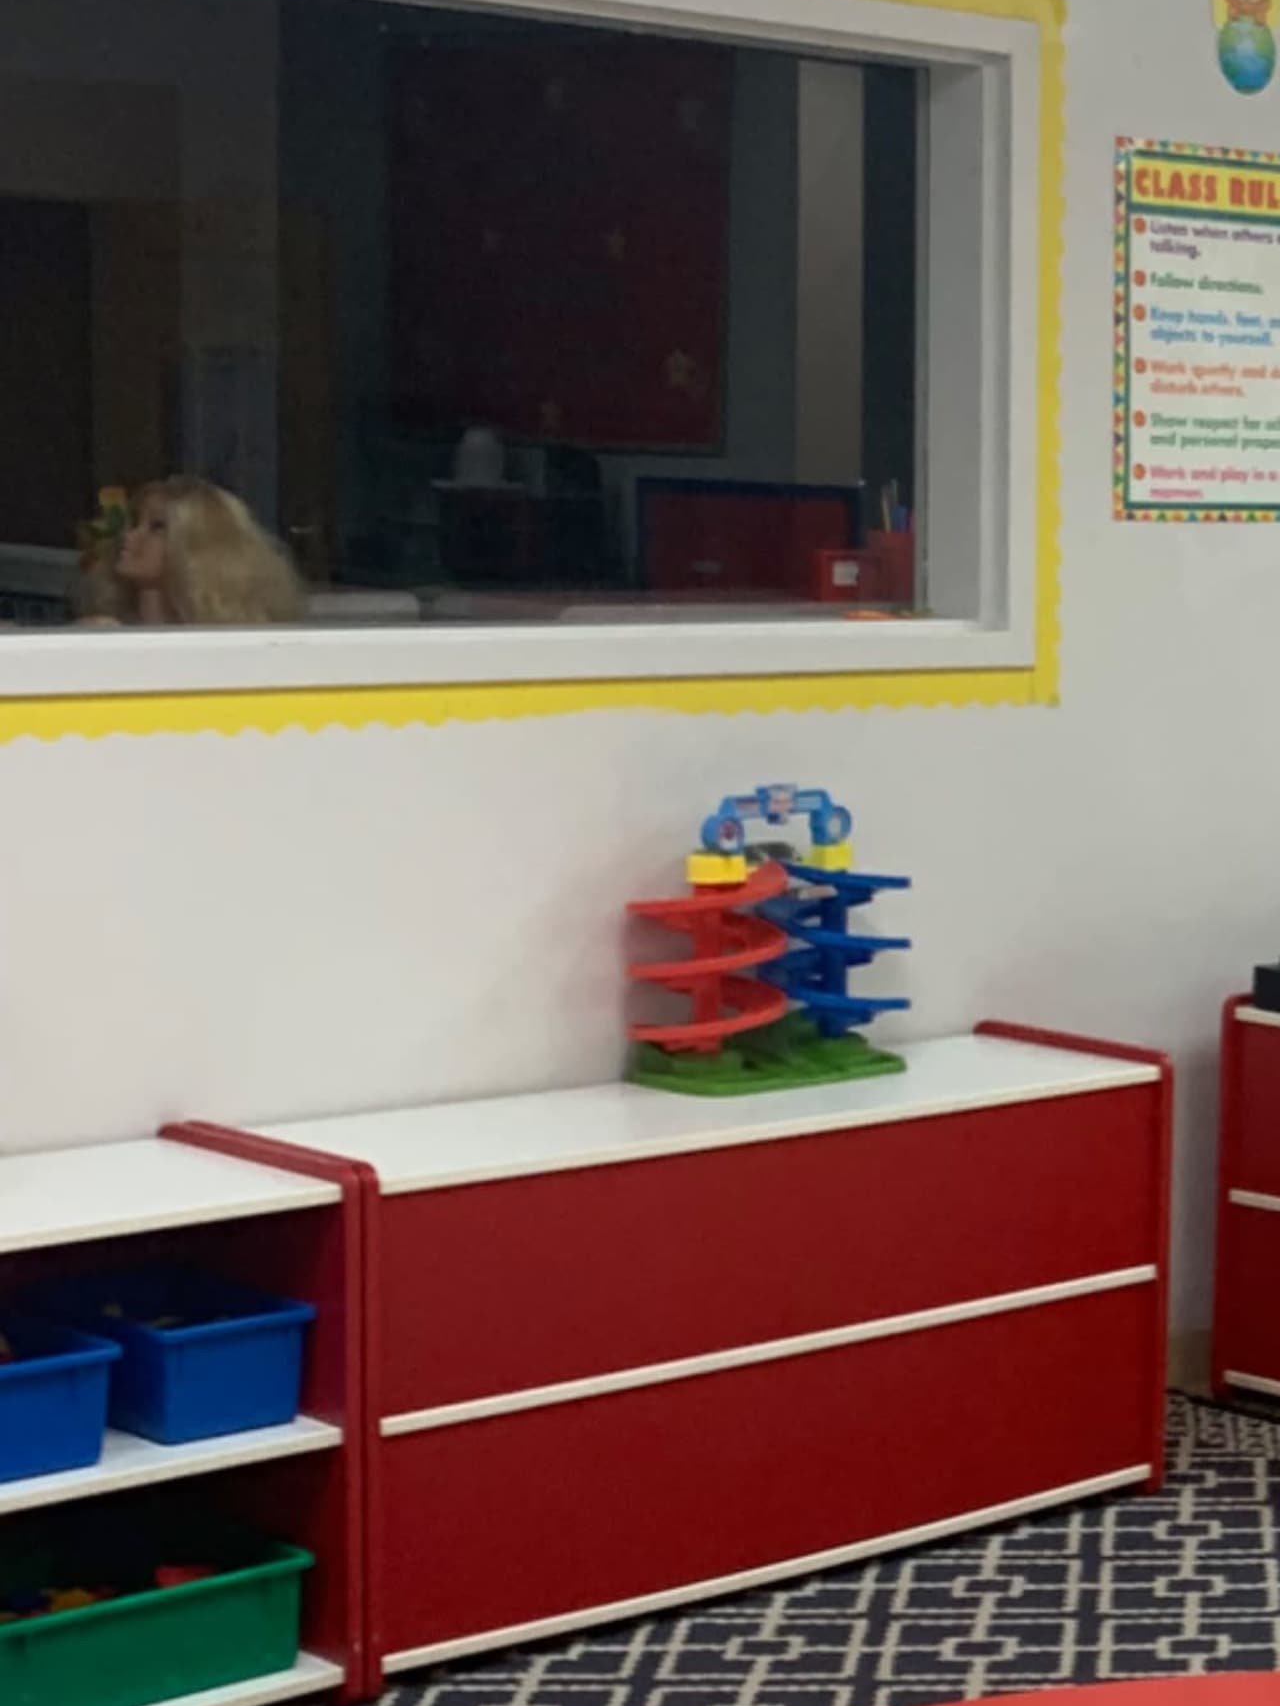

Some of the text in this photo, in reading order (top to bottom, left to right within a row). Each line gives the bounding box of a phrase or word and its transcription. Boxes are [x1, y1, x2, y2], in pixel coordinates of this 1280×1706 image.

[1134, 167, 1218, 203] CLASS
[1150, 219, 1188, 236] Listen
[1192, 225, 1228, 239] when
[1232, 227, 1274, 244] others
[1150, 271, 1194, 289] Follow
[1150, 306, 1184, 326] Keep
[1201, 329, 1215, 342] to
[1150, 431, 1176, 446] and
[1190, 466, 1217, 481] and
[1220, 465, 1250, 483] play
